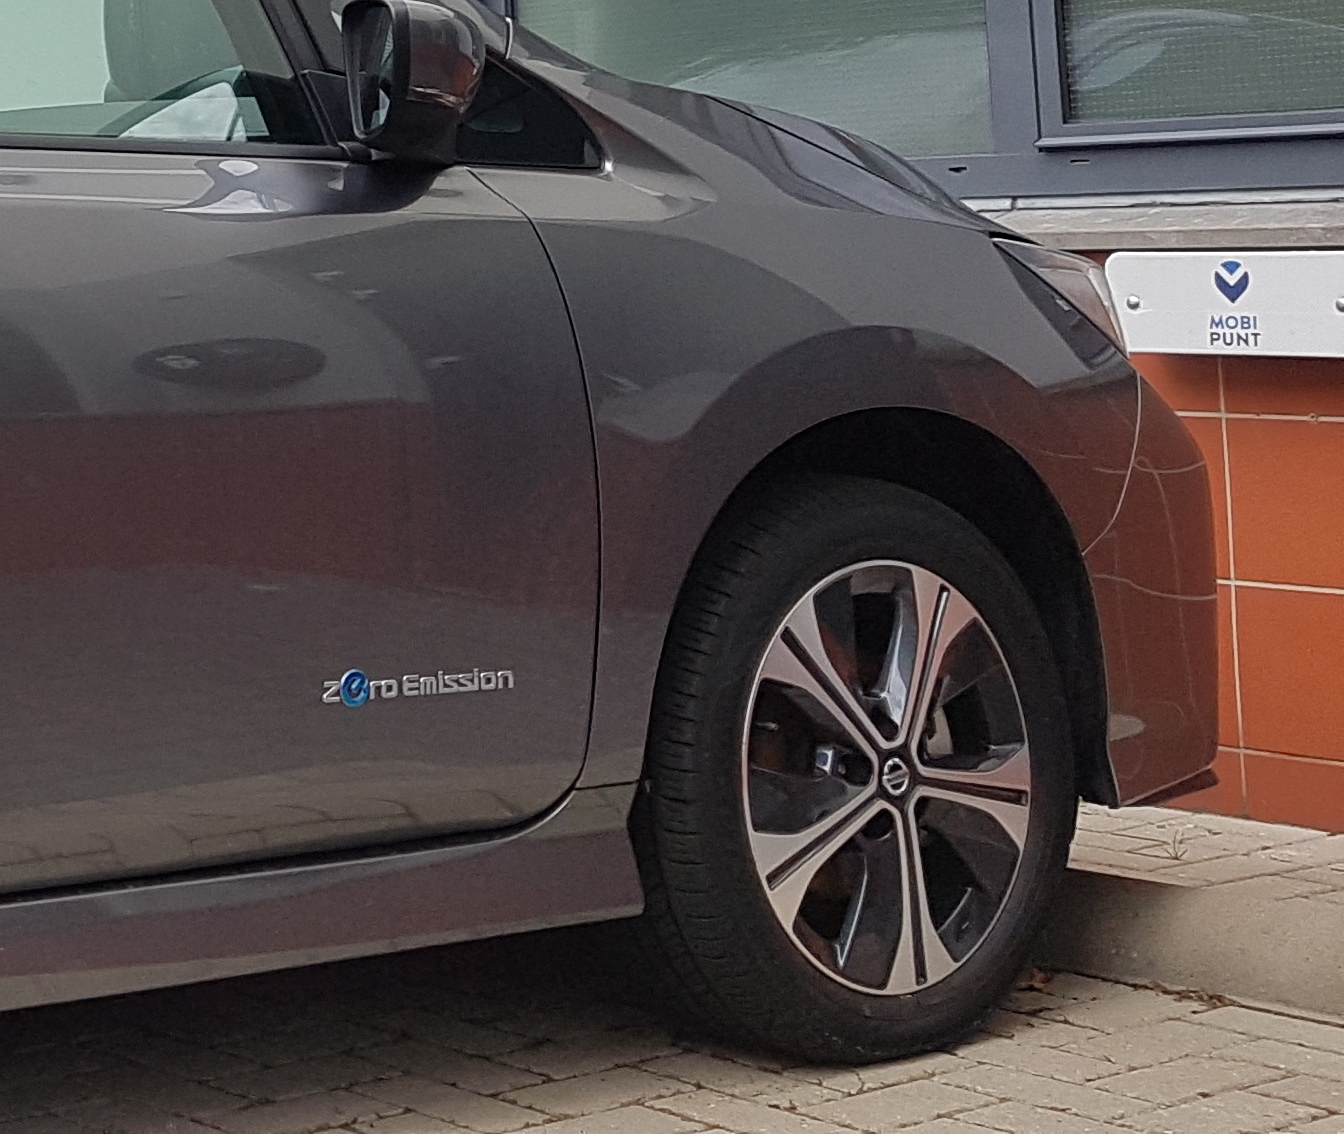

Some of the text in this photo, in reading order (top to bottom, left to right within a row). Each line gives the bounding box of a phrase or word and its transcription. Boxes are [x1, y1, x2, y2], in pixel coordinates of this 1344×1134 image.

[1209, 315, 1258, 330] MOBI
[1209, 332, 1262, 347] PUNT
[402, 667, 515, 698] Emission
